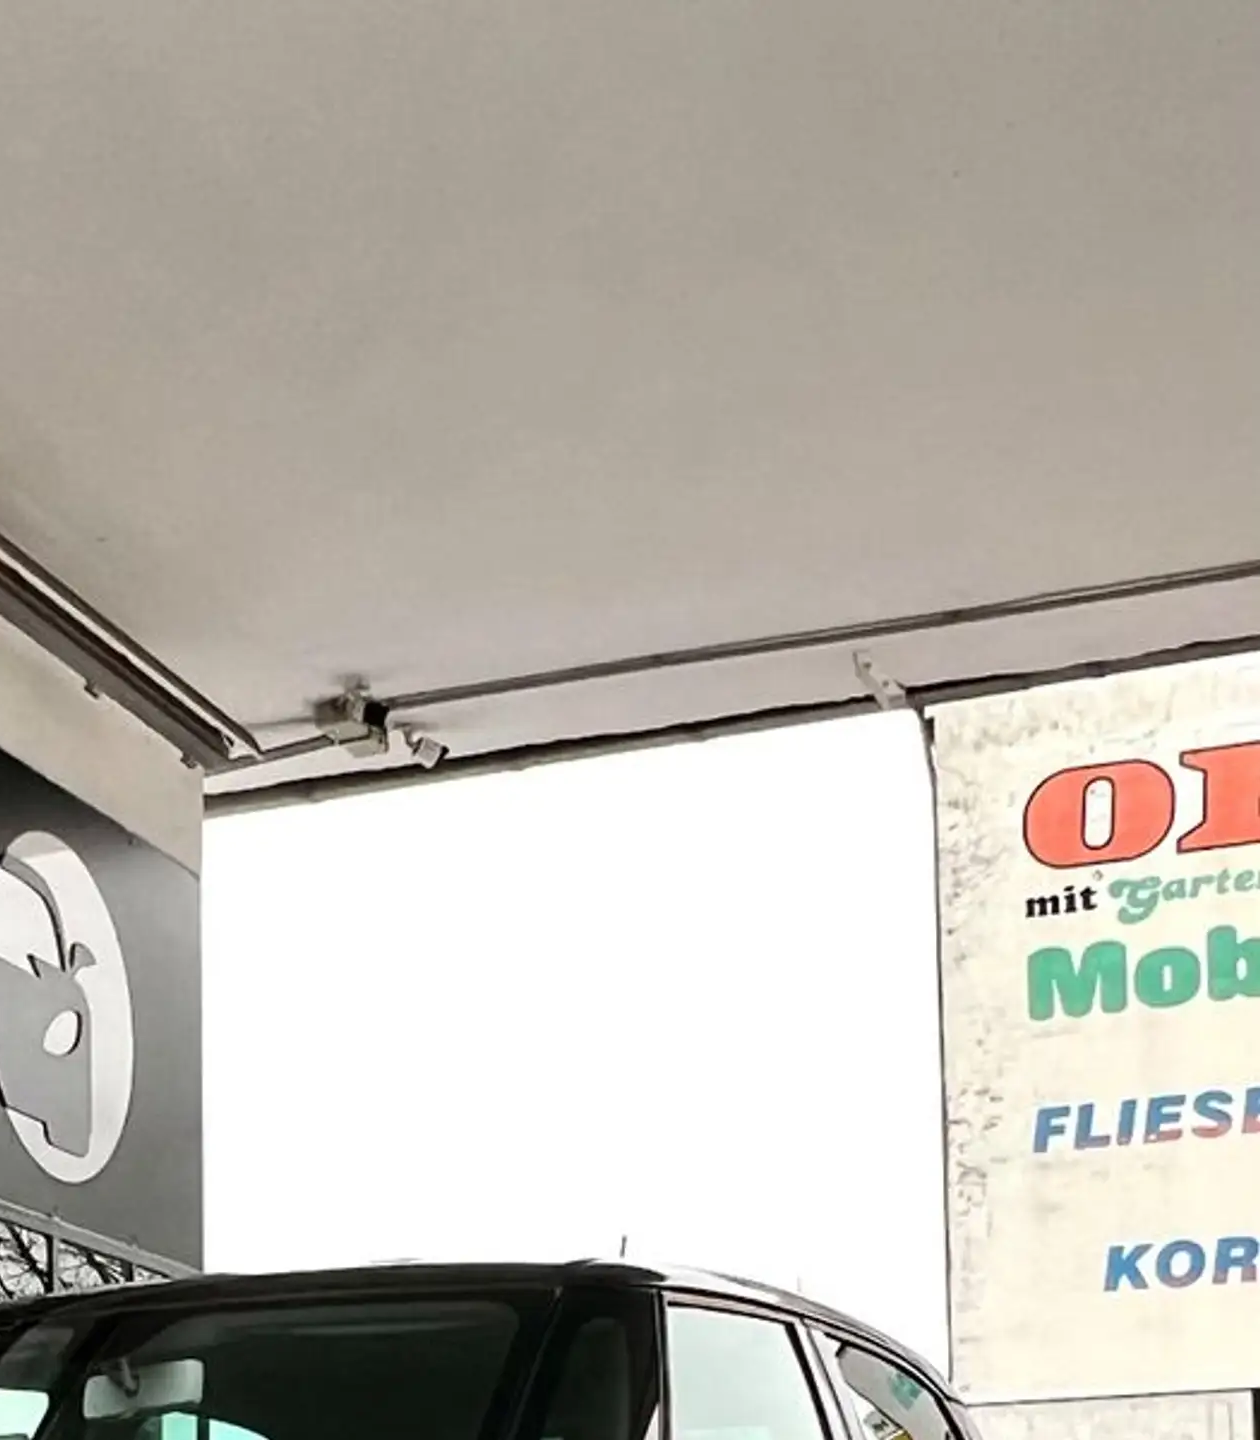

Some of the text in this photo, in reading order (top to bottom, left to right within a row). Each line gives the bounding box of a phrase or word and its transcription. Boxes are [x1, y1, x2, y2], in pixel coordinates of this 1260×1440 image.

[1025, 868, 1260, 925] mit Garte
[1026, 924, 1260, 1021] Mob
[1103, 1236, 1260, 1292] KOR
